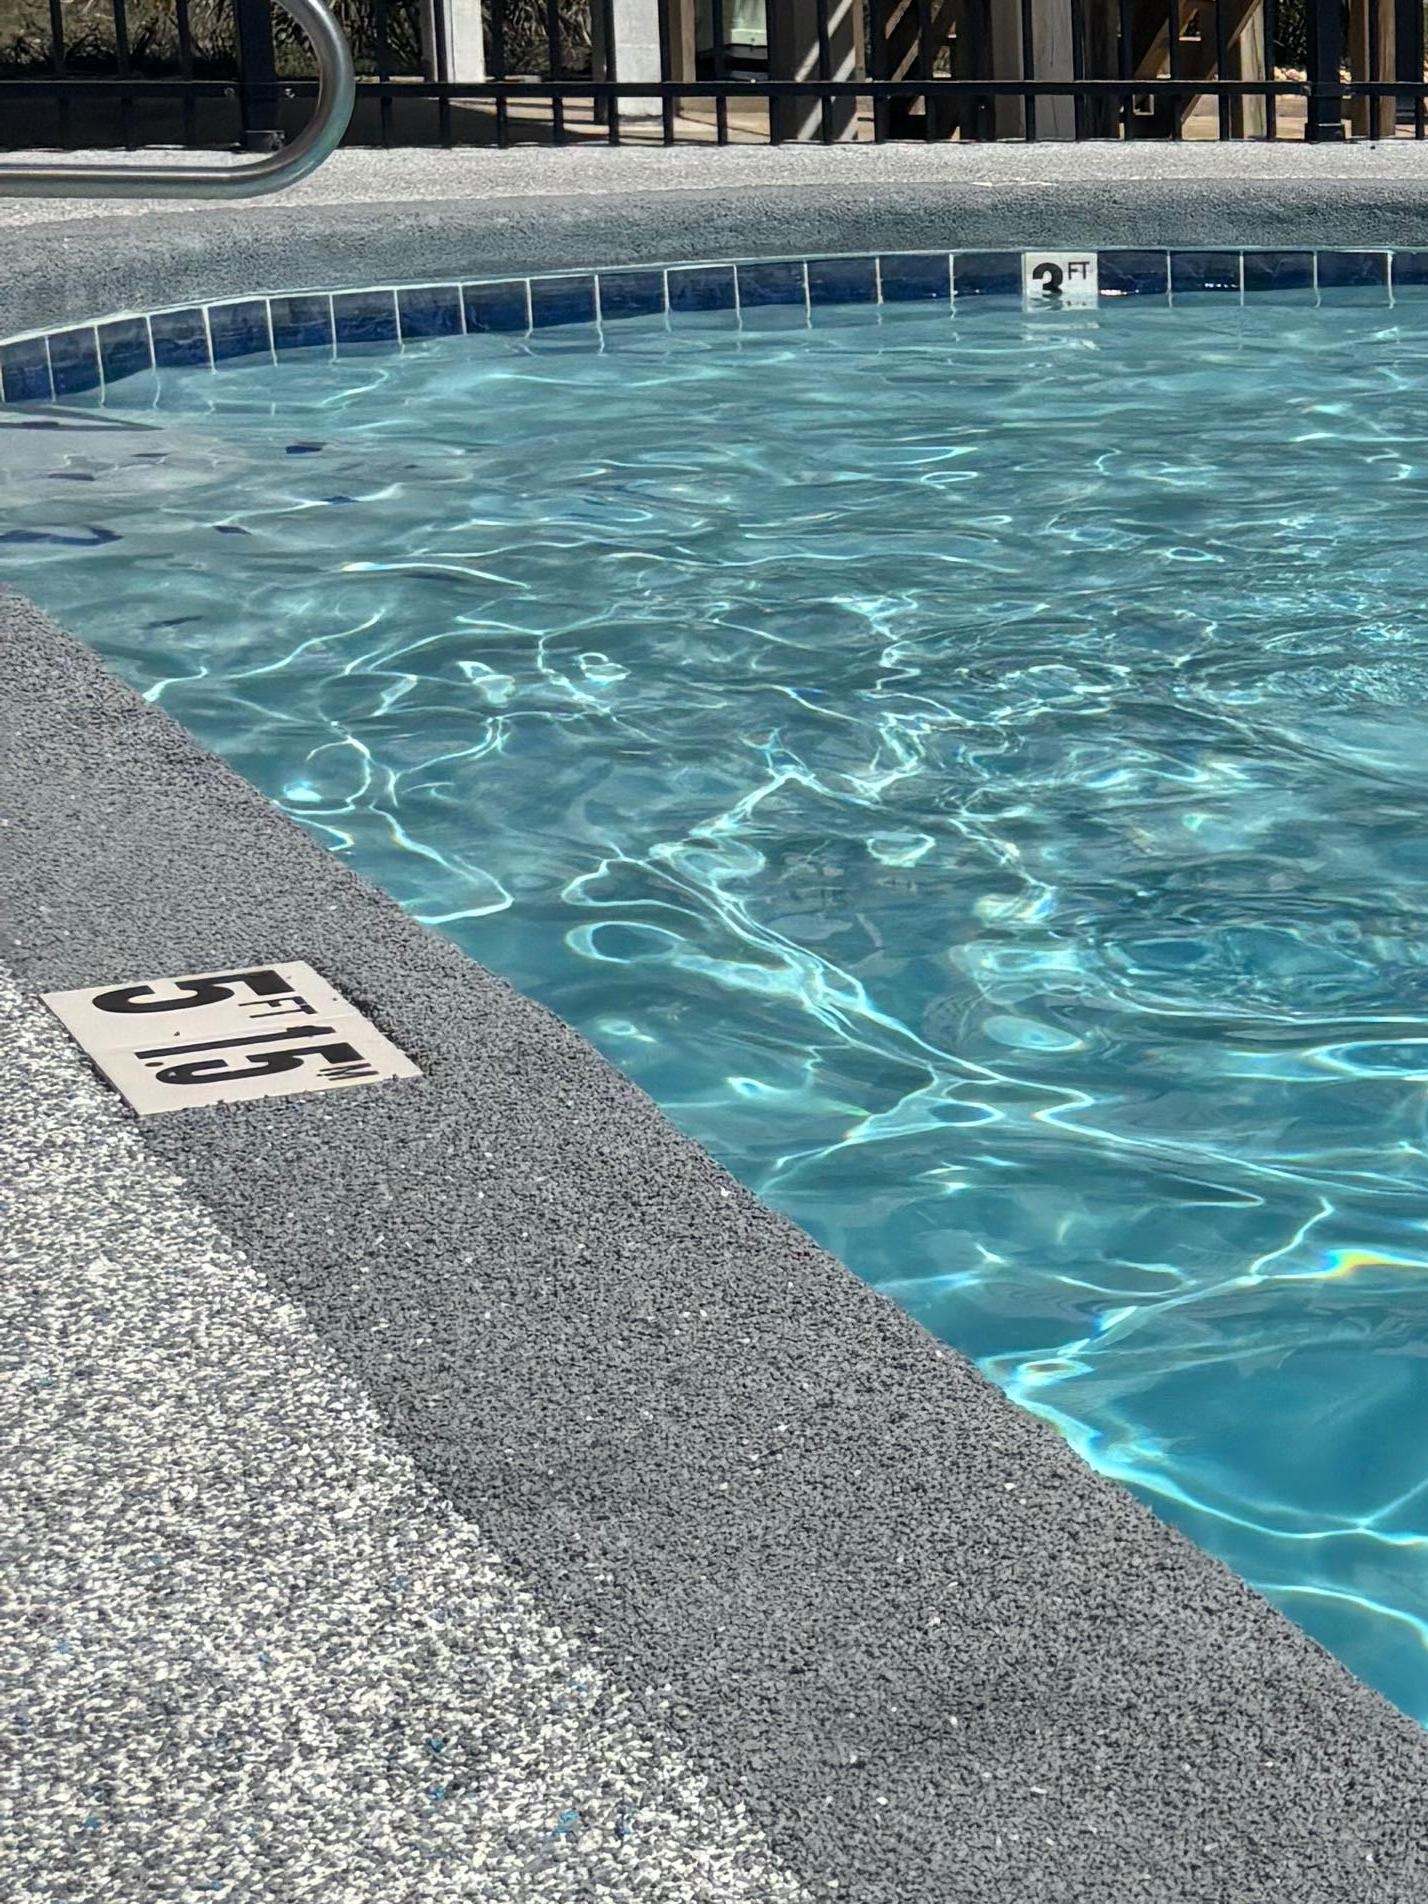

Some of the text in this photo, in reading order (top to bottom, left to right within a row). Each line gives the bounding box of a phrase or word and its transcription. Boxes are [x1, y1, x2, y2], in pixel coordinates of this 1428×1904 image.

[1032, 261, 1090, 297] 3 FT
[92, 969, 317, 1019] 5 FT
[134, 1024, 366, 1086] 1.5
